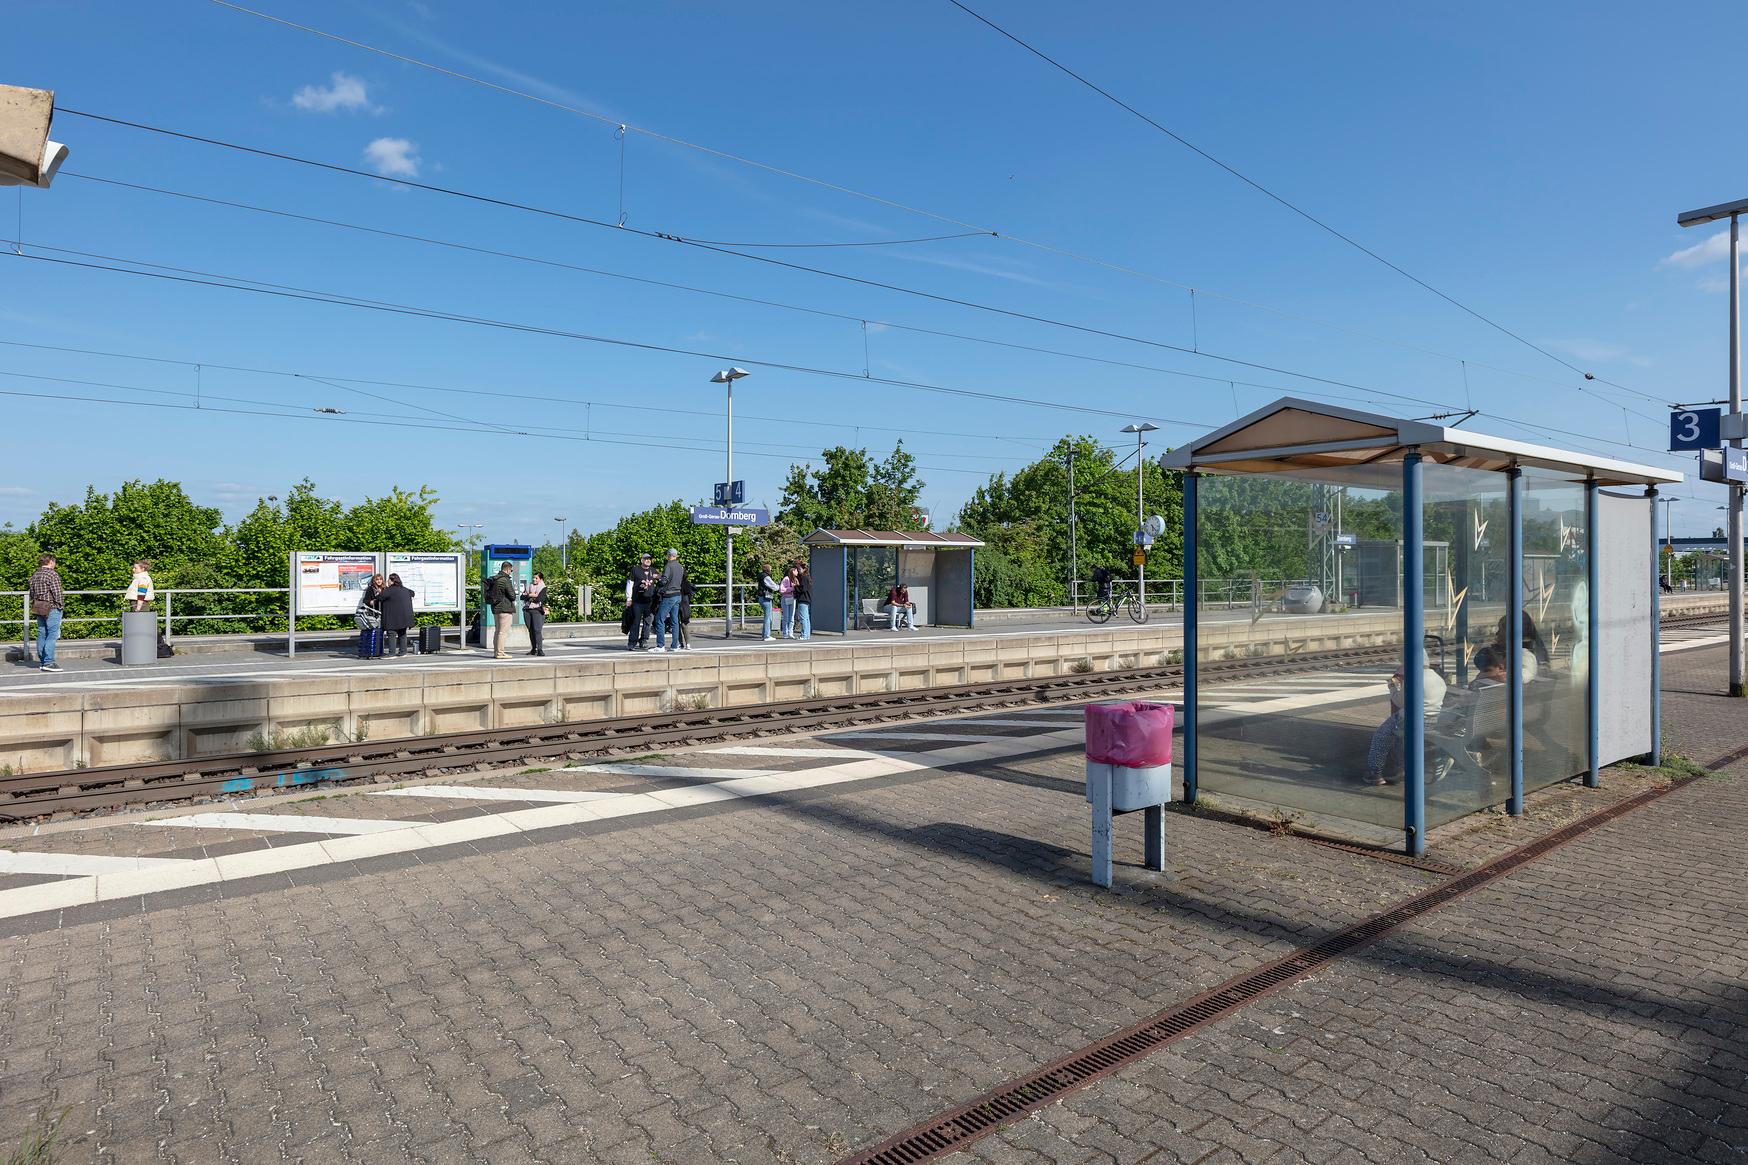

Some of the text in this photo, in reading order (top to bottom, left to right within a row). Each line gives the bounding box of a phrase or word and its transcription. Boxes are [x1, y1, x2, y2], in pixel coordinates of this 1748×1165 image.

[1676, 412, 1700, 442] 3
[715, 484, 722, 500] 5
[735, 481, 742, 499] 4
[1317, 513, 1328, 523] 54
